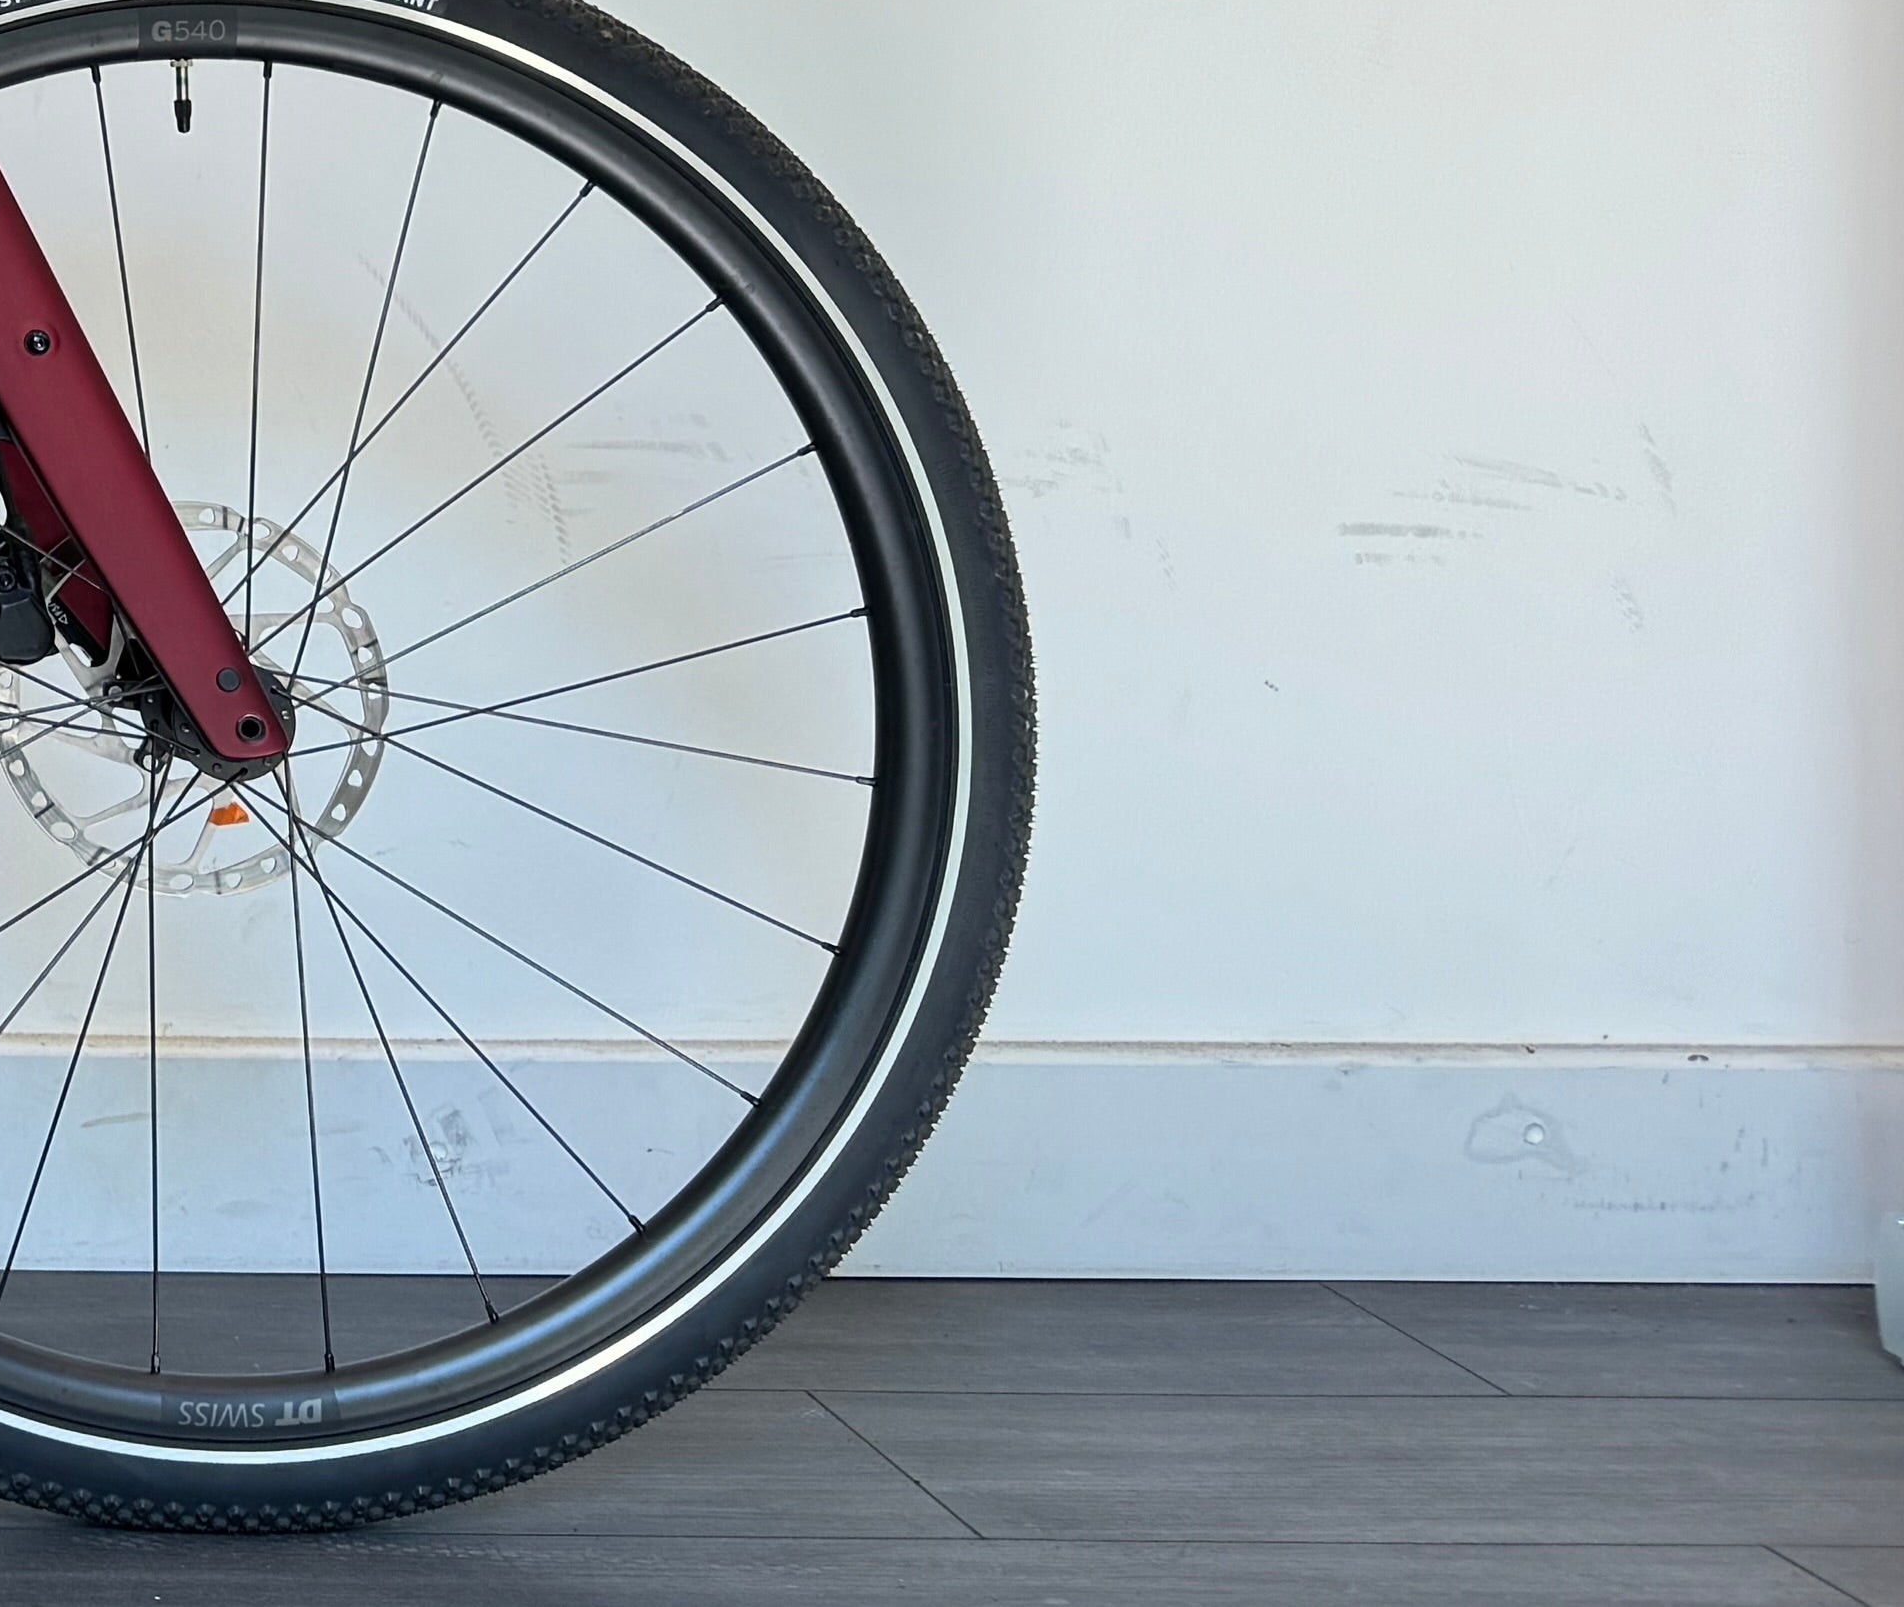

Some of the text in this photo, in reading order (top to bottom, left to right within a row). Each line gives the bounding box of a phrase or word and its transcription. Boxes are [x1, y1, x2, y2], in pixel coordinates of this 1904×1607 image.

[151, 19, 226, 43] G540
[177, 1397, 323, 1428] DT SWISS
